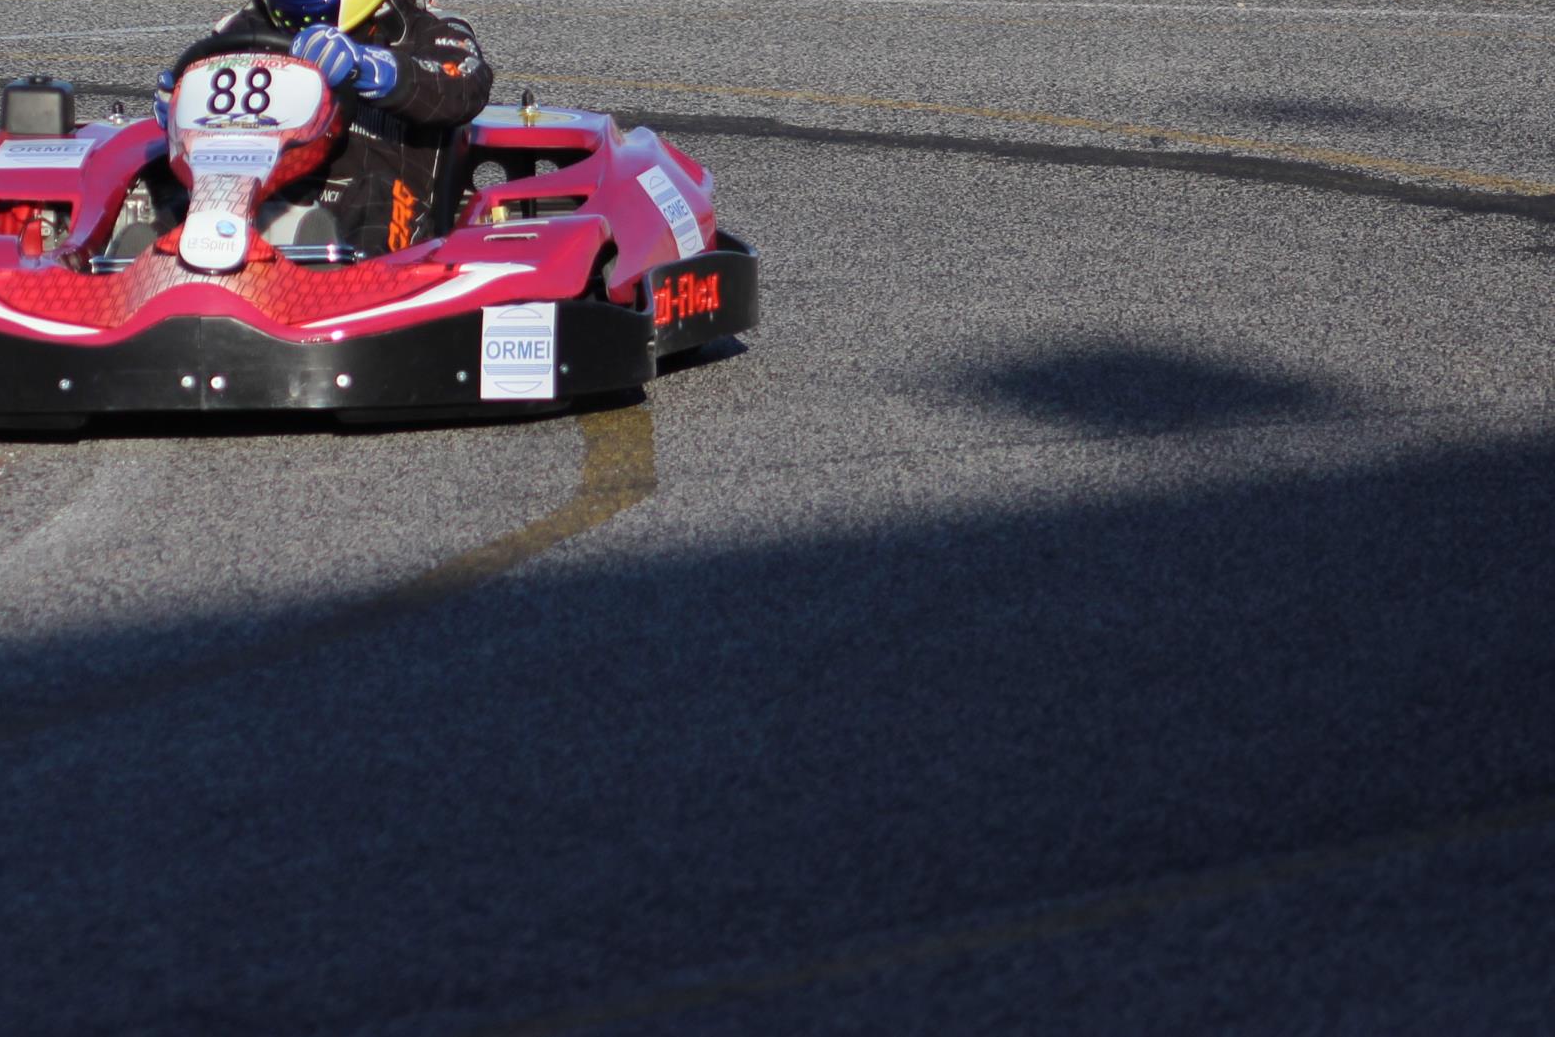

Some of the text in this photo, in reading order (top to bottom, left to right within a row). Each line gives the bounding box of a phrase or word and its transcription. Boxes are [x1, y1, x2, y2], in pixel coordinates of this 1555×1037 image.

[206, 66, 273, 115] 88
[8, 145, 86, 154] ORMEI
[192, 154, 274, 163] ORMEI
[485, 340, 551, 361] ORMEI
